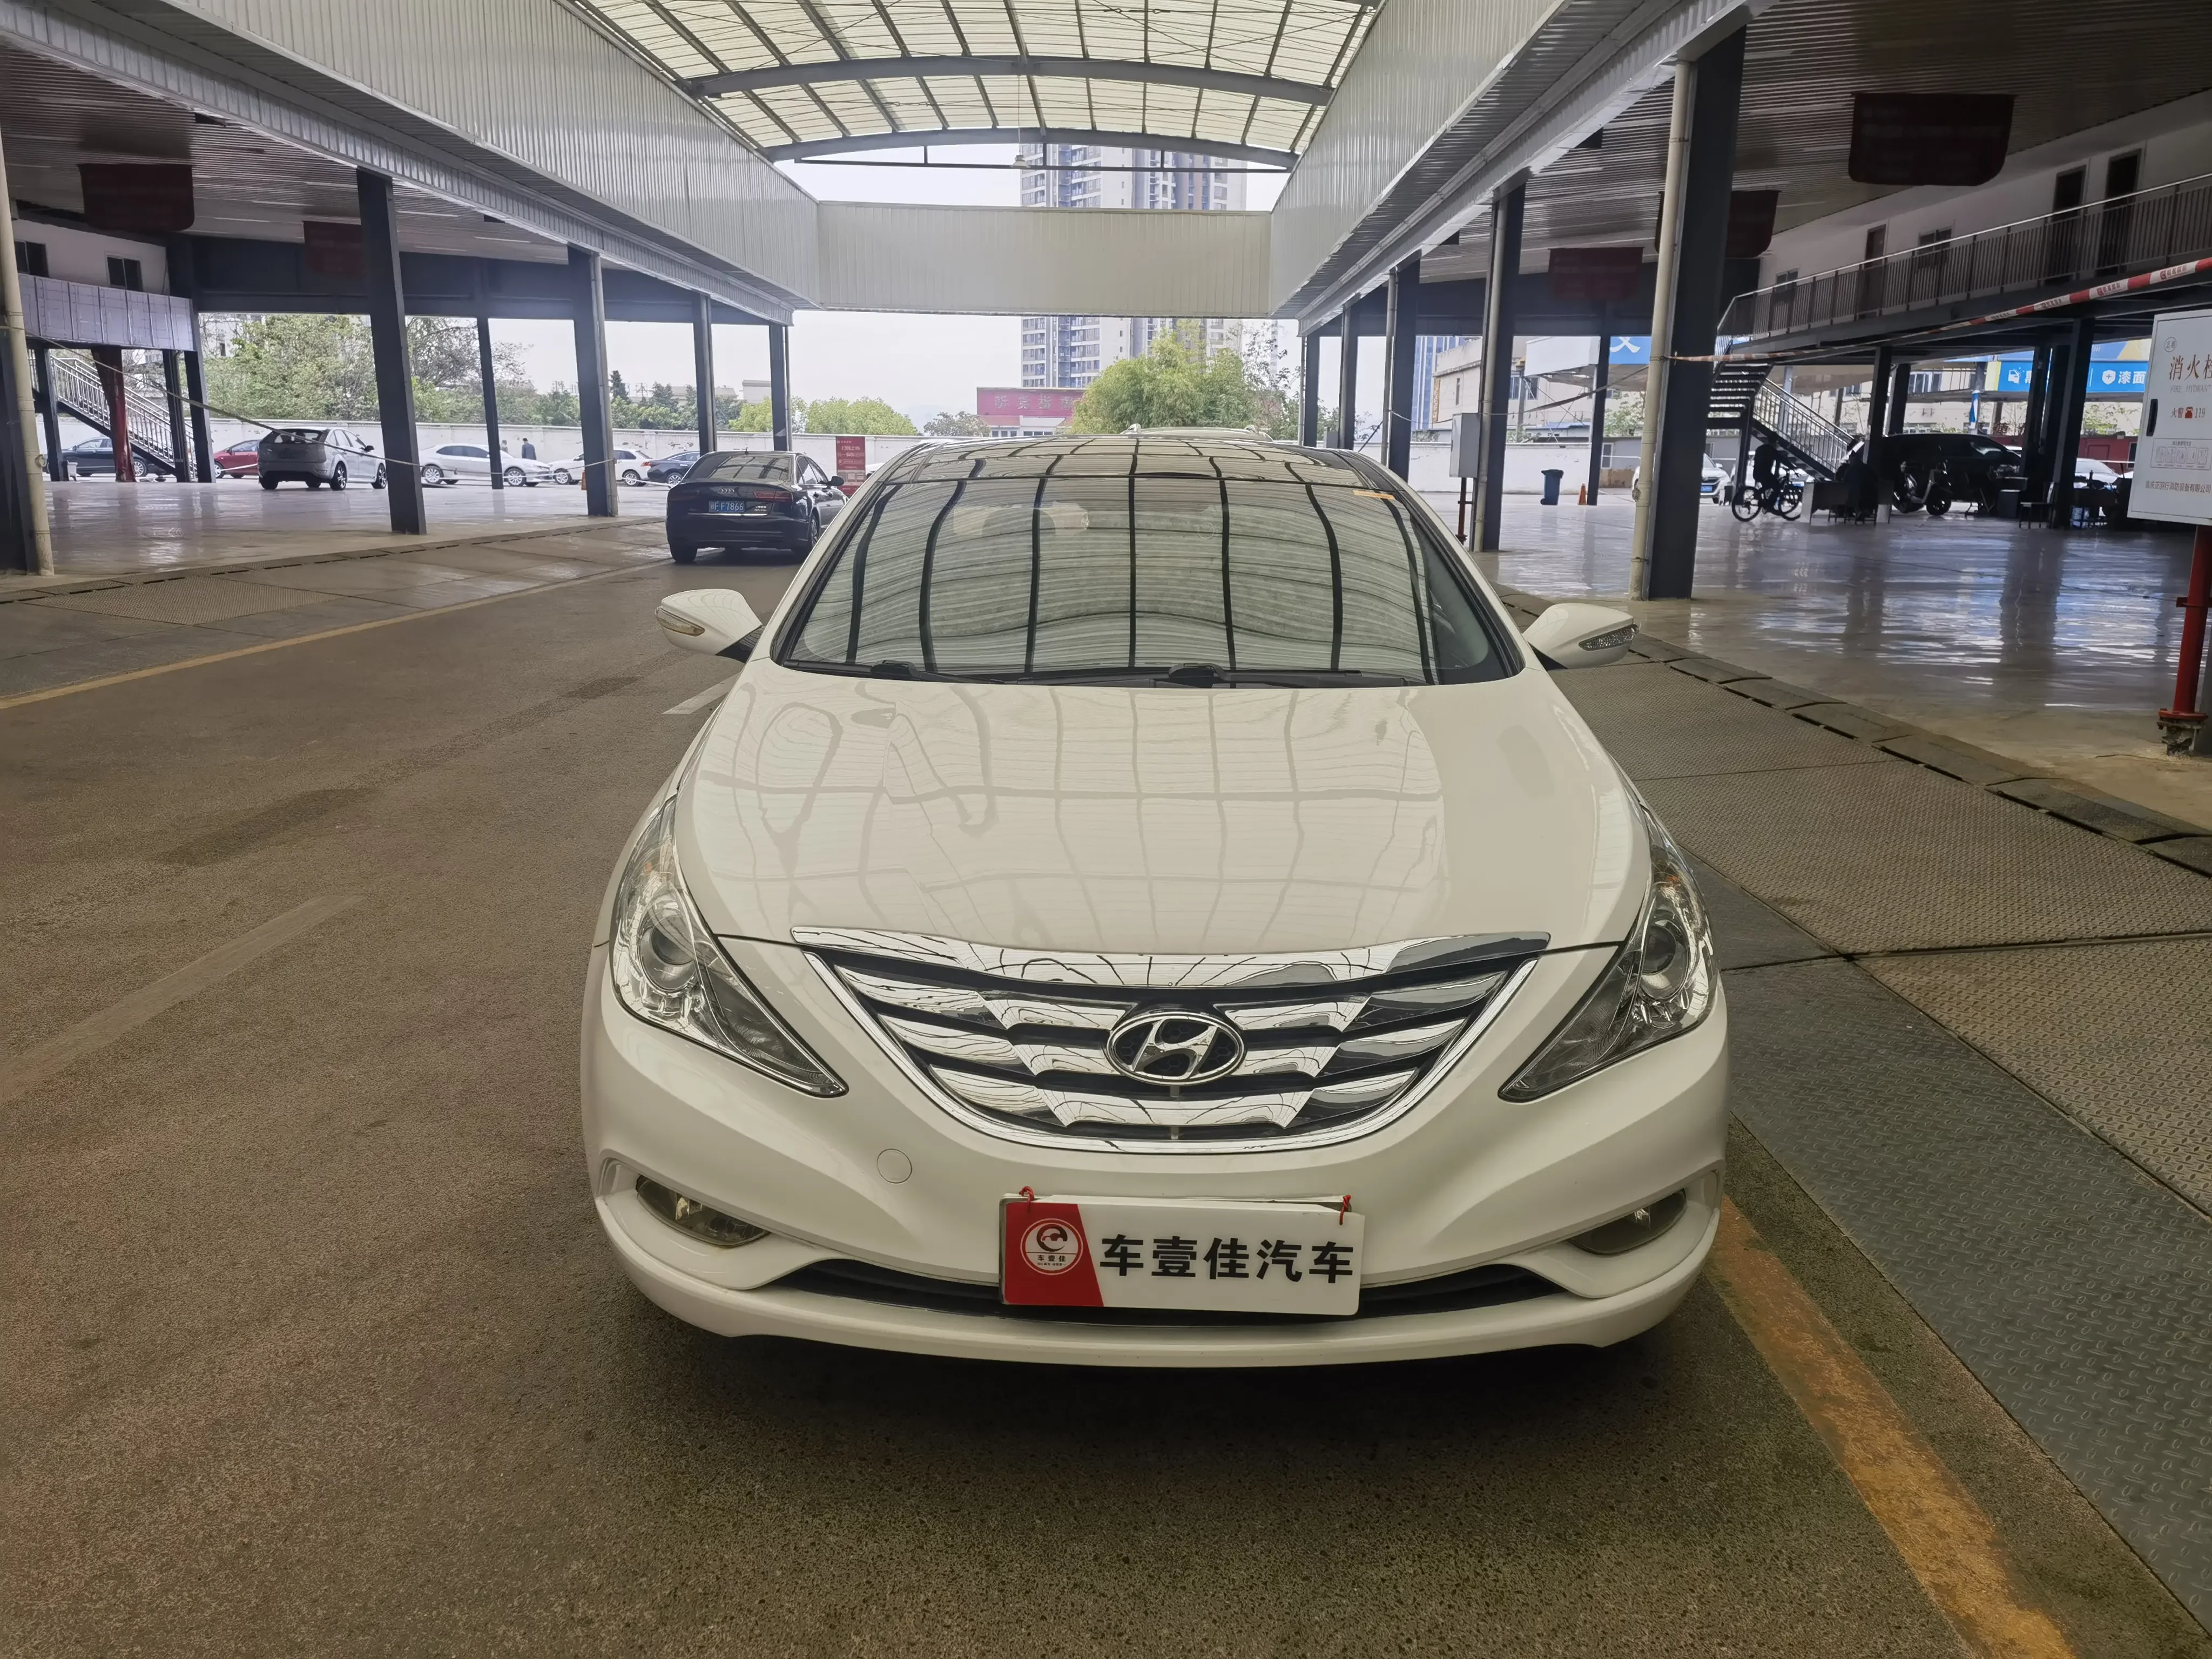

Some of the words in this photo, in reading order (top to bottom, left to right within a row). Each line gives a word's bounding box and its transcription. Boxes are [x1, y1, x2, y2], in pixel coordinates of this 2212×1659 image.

[2117, 370, 2147, 385] 漆面
[1100, 1233, 1354, 1284] 车壹佳汽车
